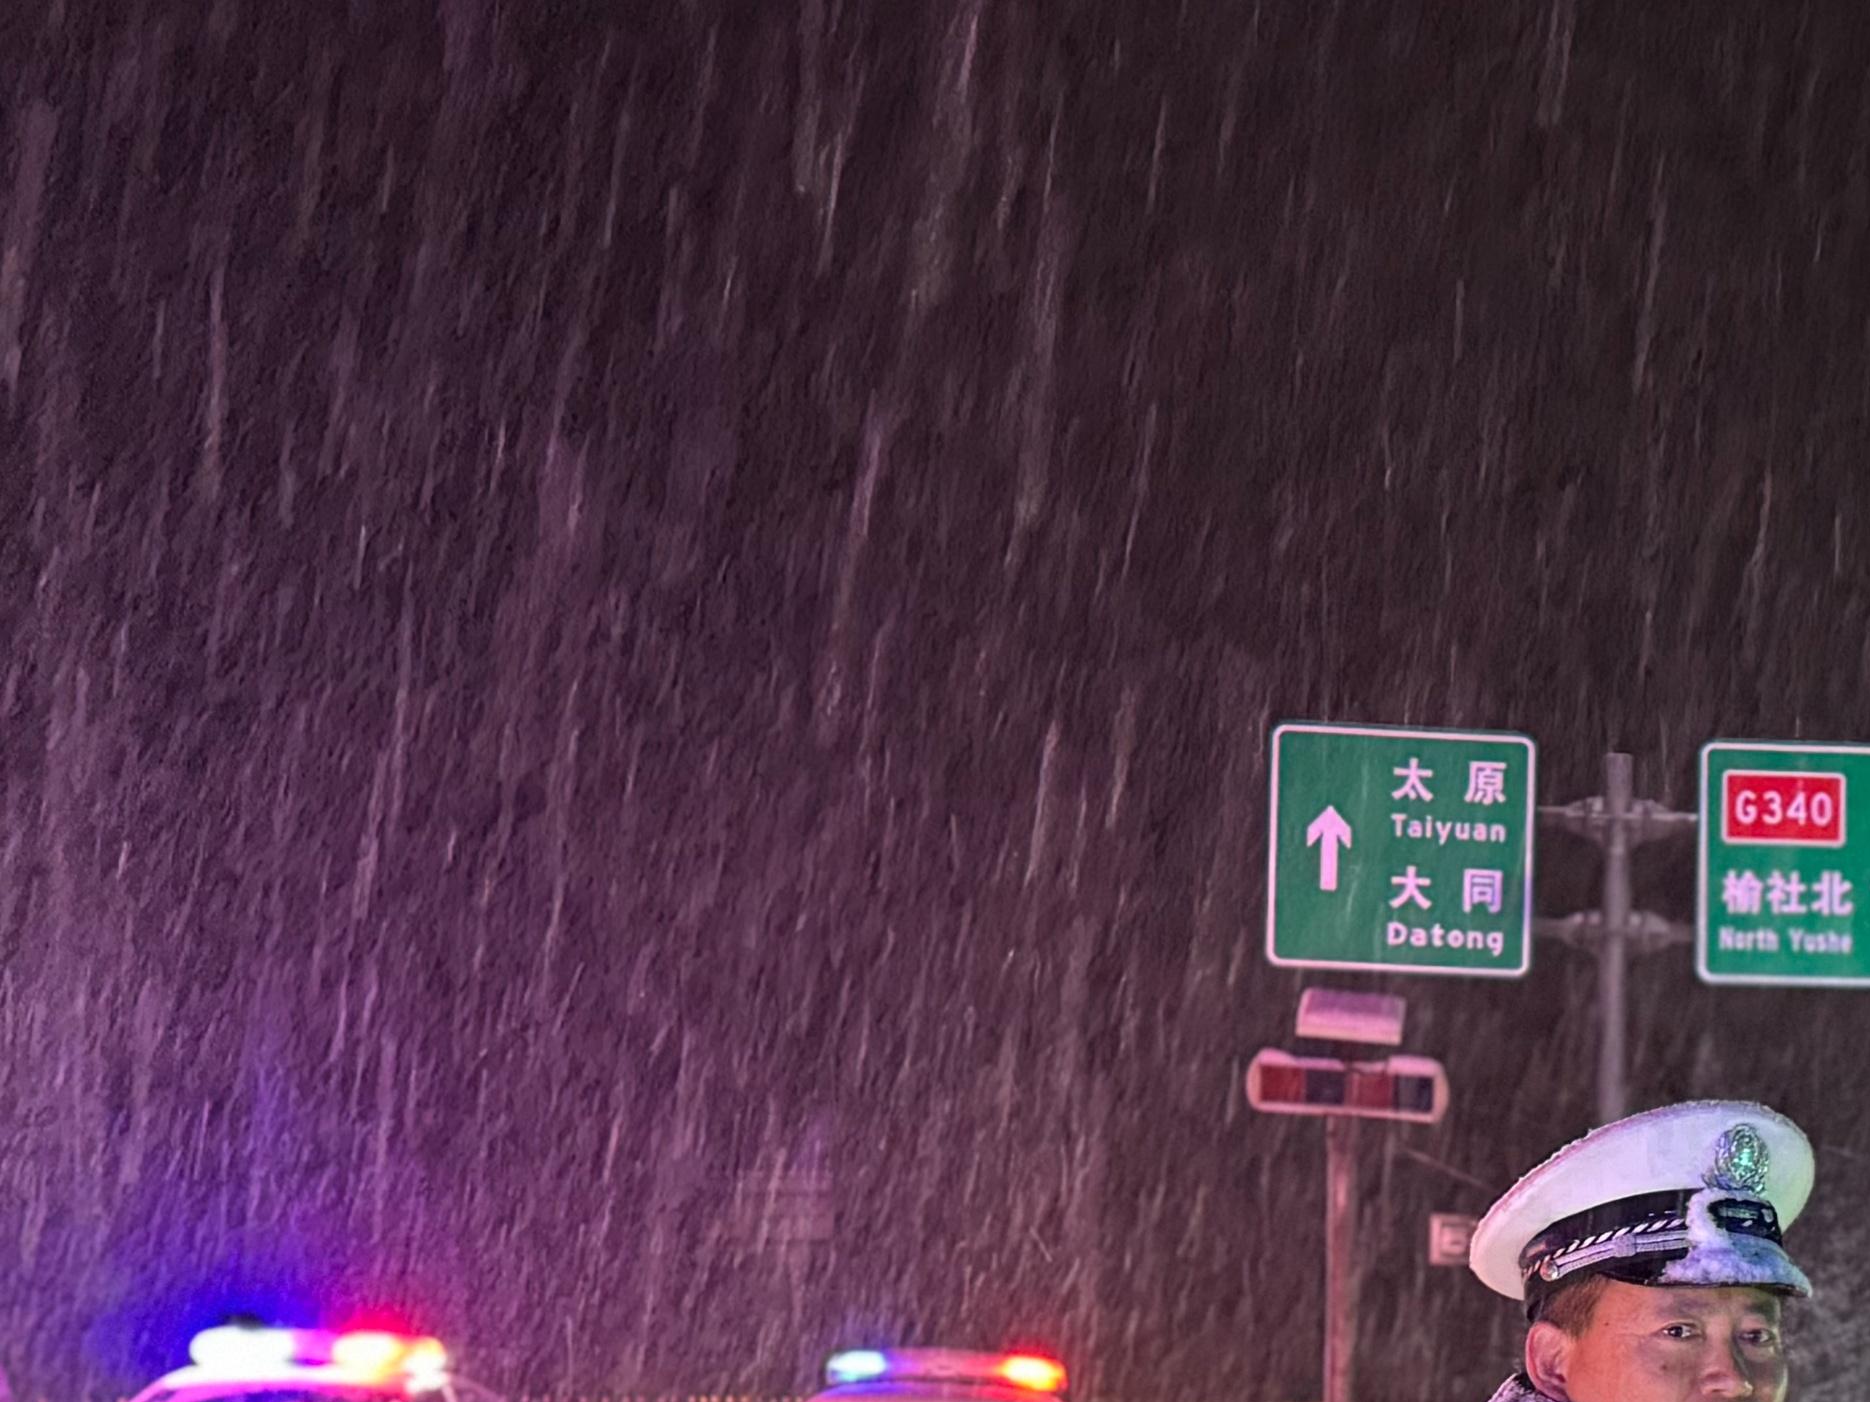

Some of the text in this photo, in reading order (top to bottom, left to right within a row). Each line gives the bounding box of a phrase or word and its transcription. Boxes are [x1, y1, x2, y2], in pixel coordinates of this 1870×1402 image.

[1391, 757, 1507, 805] 太原
[1735, 789, 1833, 827] G340
[1390, 813, 1507, 846] Taiyuan
[1388, 865, 1504, 914] 大同
[1722, 868, 1854, 917] 榆社北
[1387, 921, 1504, 957] Datong
[1719, 925, 1780, 951] North
